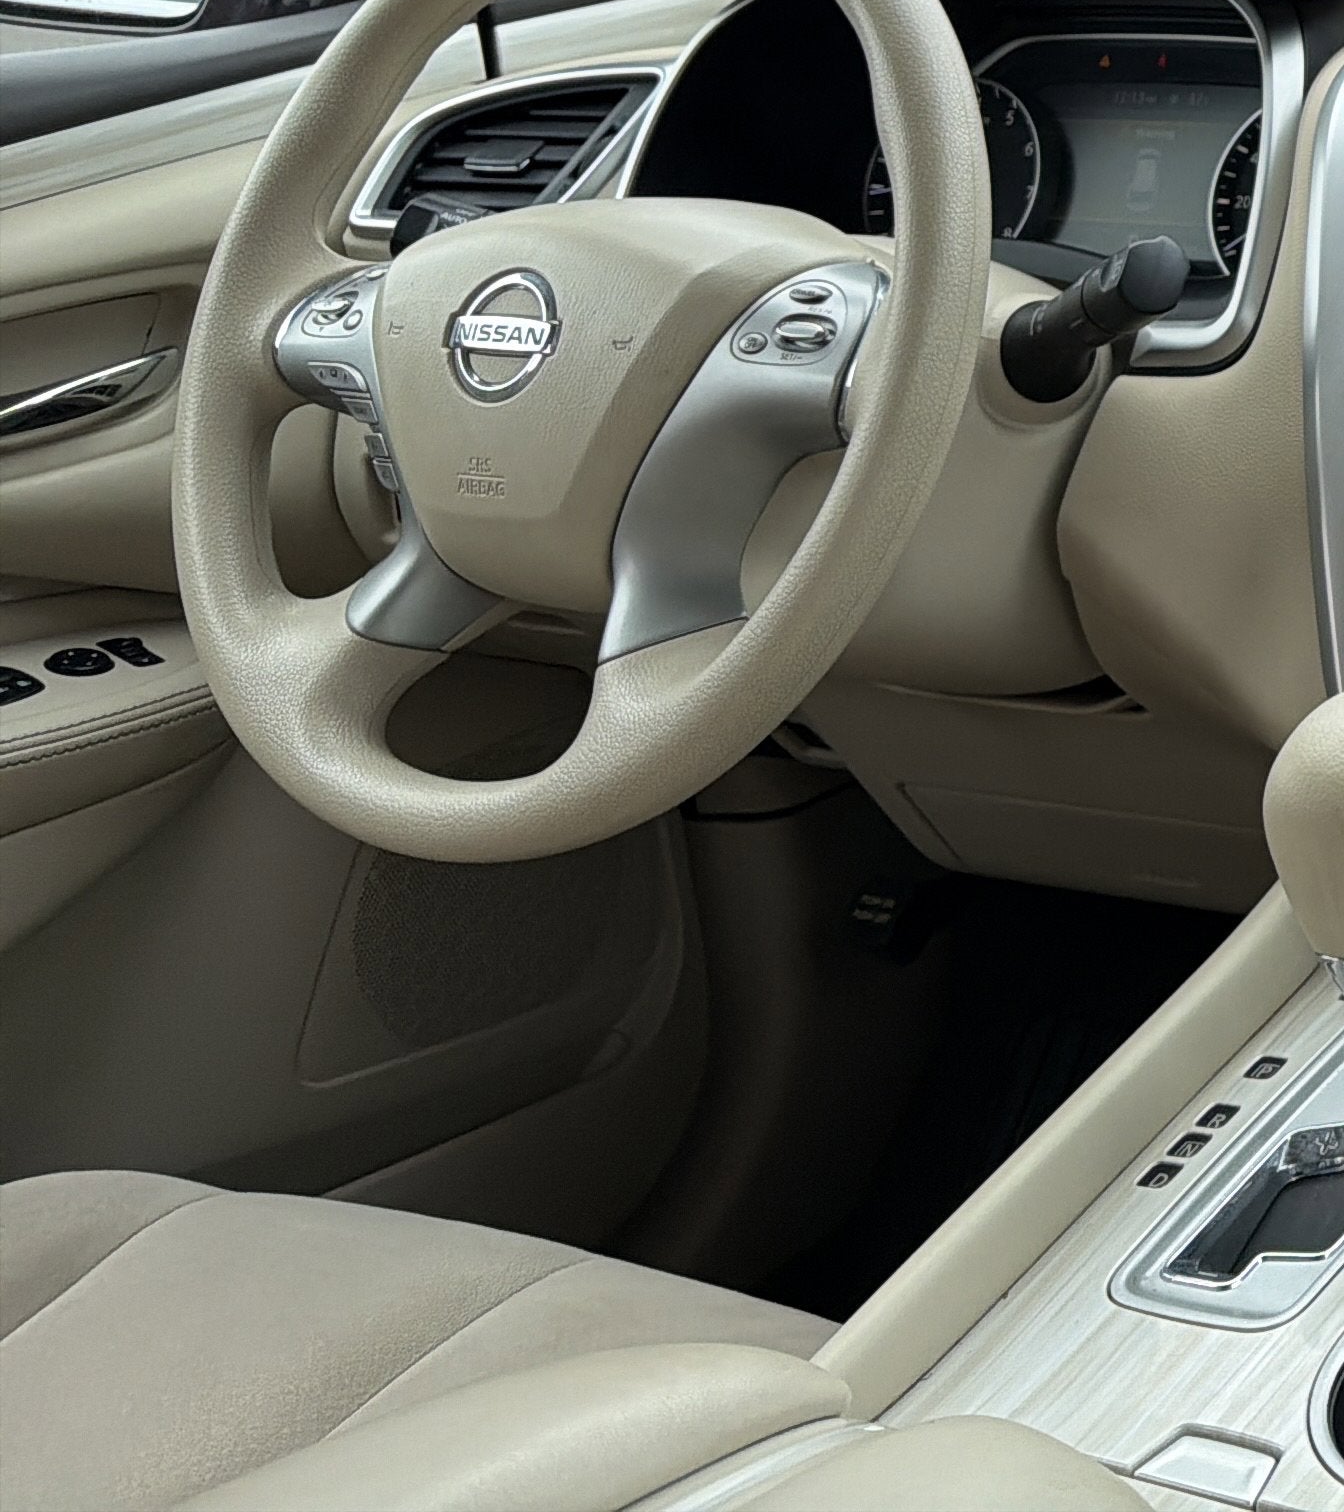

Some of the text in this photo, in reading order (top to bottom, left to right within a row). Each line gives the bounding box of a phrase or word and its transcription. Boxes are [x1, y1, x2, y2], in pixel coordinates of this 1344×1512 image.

[1024, 141, 1034, 157] 6
[457, 322, 546, 346] NISSAN
[467, 456, 493, 474] SRS
[456, 477, 506, 498] AIRBAG
[1207, 1113, 1227, 1129] R
[1149, 1172, 1169, 1188] D
